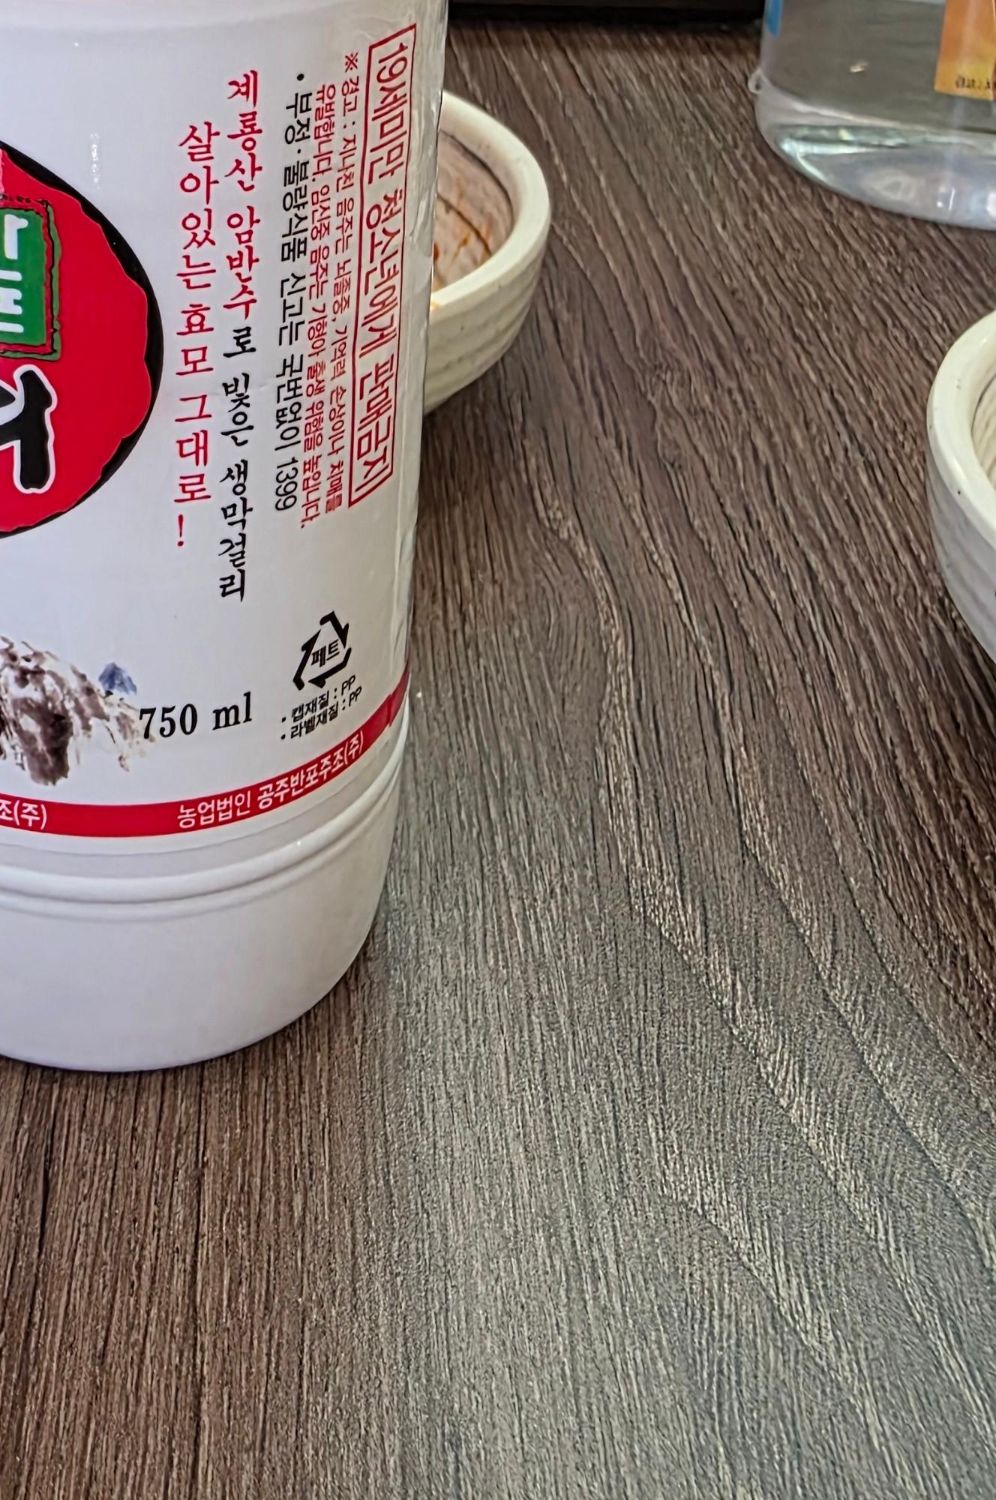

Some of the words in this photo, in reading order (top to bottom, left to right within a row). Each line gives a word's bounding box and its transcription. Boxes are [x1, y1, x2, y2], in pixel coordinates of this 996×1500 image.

[341, 75, 360, 117] 경고
[367, 41, 410, 185] 19세미만
[224, 69, 264, 192] 계룡산
[311, 83, 337, 183] 유발합니다.
[335, 133, 358, 194] 지나친
[175, 120, 221, 290] 살아있는
[310, 184, 331, 241] 임신중
[334, 196, 355, 255] 음주는
[308, 244, 331, 300] 음주는
[331, 258, 353, 322] 뇌졸중,
[358, 188, 403, 359] 청소년에게
[277, 272, 307, 347] 신고는
[307, 302, 328, 358] 기형아
[305, 360, 326, 398] 출생
[329, 324, 348, 382] 기억력
[220, 372, 255, 447] 빚은
[274, 353, 304, 452] 국번없이
[303, 399, 325, 454] 위험을
[327, 384, 348, 456] 손상이나
[354, 353, 395, 493] 판매금지
[274, 455, 299, 512] 1399
[300, 453, 323, 529] 높입니다.
[324, 460, 344, 515] 치매를
[217, 459, 254, 603] 생막걸리
[311, 638, 340, 668] 페트
[138, 702, 199, 740] 750
[211, 691, 253, 731] ml
[289, 701, 340, 740] 라벨재질
[290, 690, 331, 722] 캡재질
[176, 790, 252, 830] 농업법인
[256, 730, 365, 810] 공주반포주조(주)
